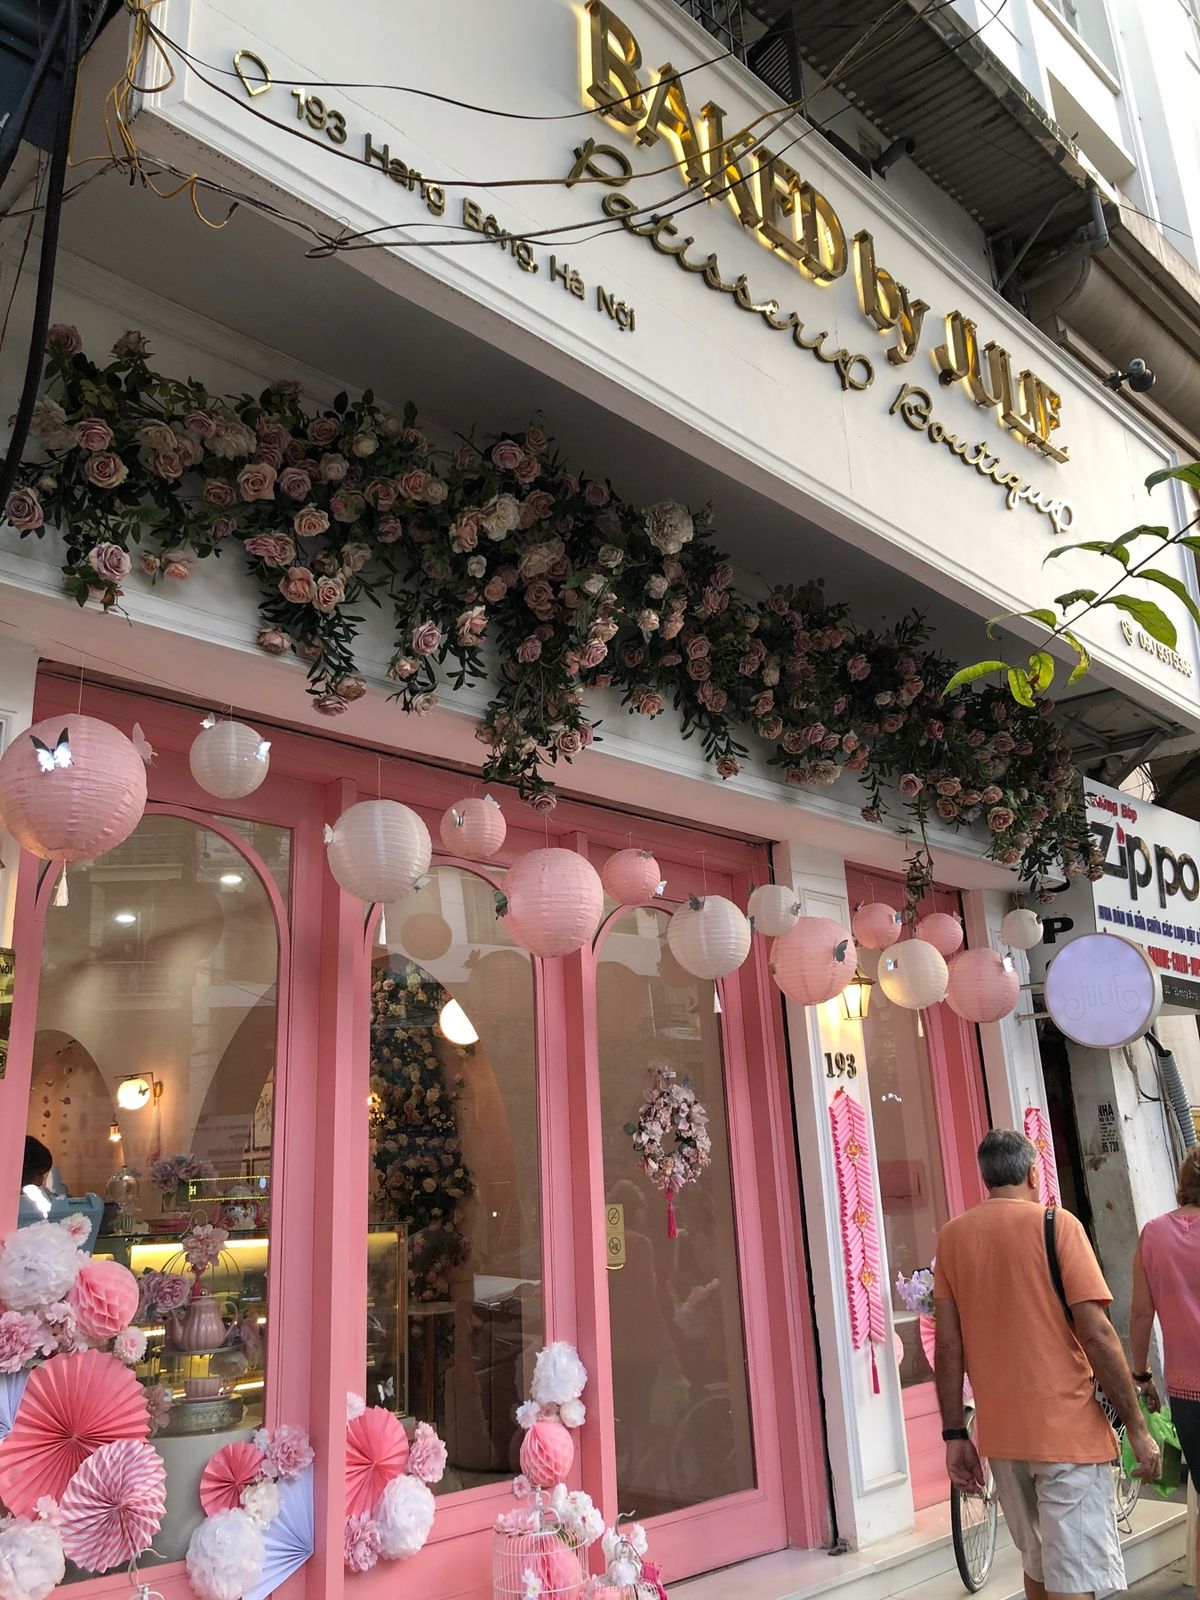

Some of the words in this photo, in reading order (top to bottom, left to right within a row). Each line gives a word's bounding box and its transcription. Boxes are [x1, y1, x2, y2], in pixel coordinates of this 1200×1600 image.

[291, 88, 347, 144] 193
[597, 285, 636, 332] Nội
[565, 137, 874, 391] Patisserie
[890, 383, 1077, 534] Boutique
[583, 0, 848, 282] BAKED
[852, 229, 930, 366] by
[934, 309, 1069, 463] JULIE
[824, 1052, 857, 1079] 193
